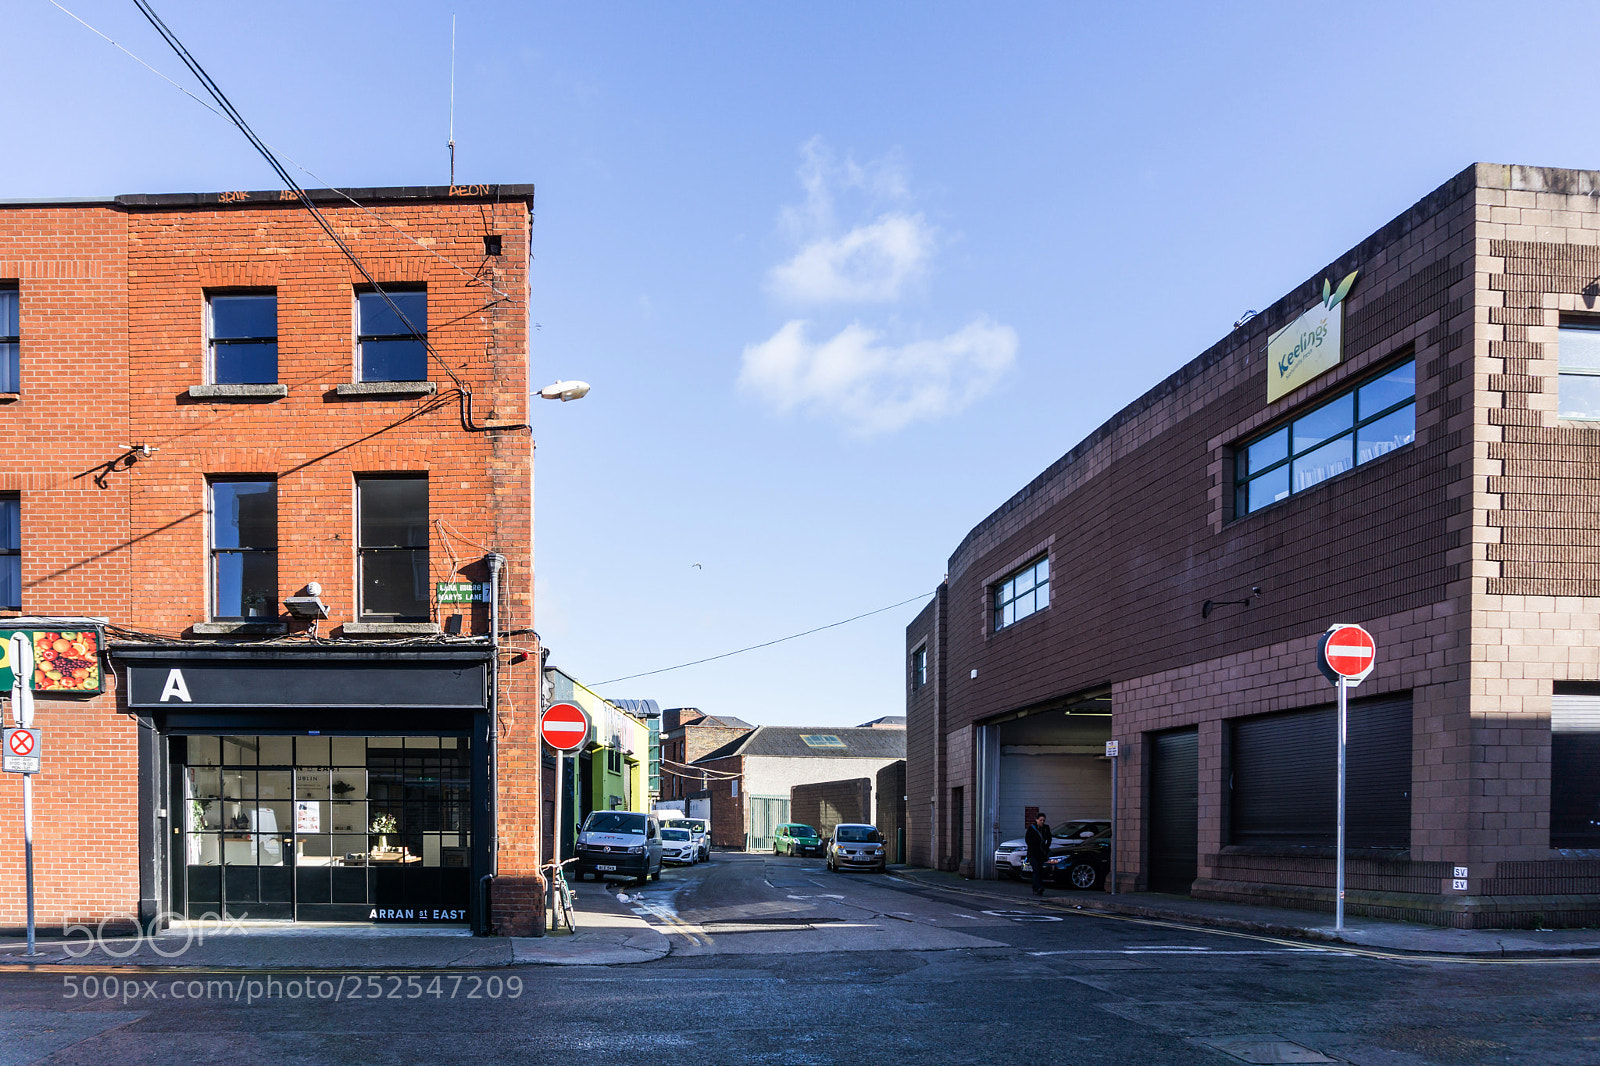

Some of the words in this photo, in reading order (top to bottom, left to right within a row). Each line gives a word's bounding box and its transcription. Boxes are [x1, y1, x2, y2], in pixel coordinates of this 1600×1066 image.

[449, 184, 489, 197] AEON
[160, 668, 192, 702] A
[369, 909, 414, 919] ARRAN
[419, 909, 428, 919] st
[432, 909, 466, 920] EAST
